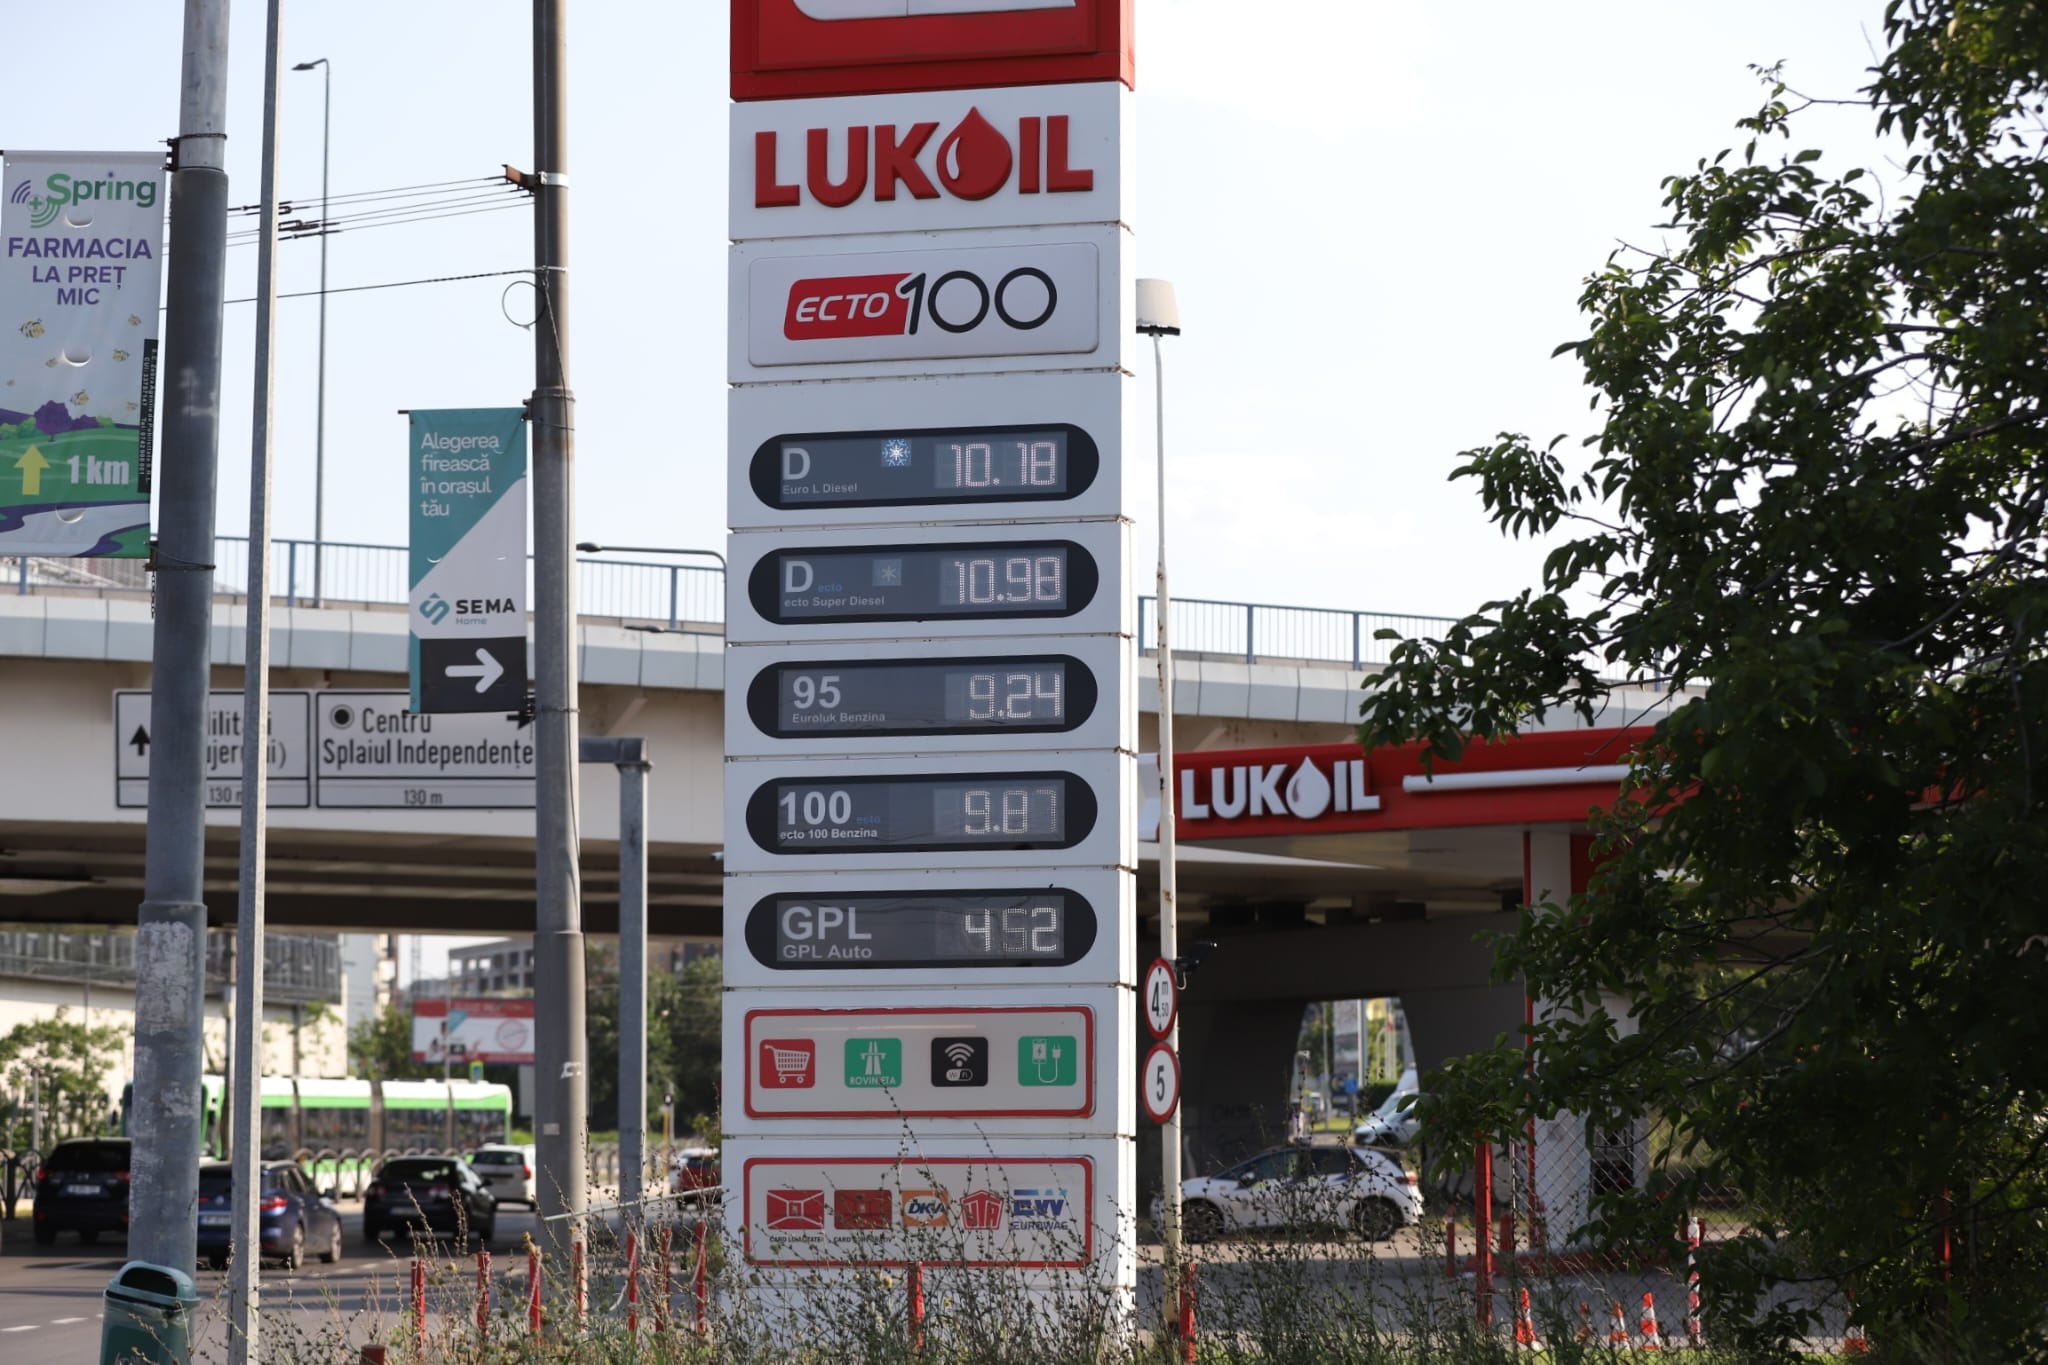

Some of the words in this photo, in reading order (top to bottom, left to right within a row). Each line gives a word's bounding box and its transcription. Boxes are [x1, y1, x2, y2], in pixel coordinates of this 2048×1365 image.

[755, 106, 1093, 208] LUKOIL
[47, 172, 157, 208] Spring
[8, 237, 153, 260] FARMACIA
[32, 265, 61, 284] LA
[68, 266, 127, 290] PREȚ
[57, 288, 100, 306] MIC
[796, 293, 890, 322] ECTO
[900, 266, 1058, 335] 100
[421, 432, 500, 453] Alegerea
[67, 455, 80, 484] 1
[87, 455, 129, 485] km
[422, 454, 490, 472] firească
[783, 448, 811, 480] D
[420, 476, 436, 494] în
[438, 476, 492, 498] orașul
[783, 484, 809, 495] Euro
[812, 483, 820, 494] L
[823, 483, 858, 493] Diesel
[420, 500, 450, 516] tău
[785, 561, 814, 593] D
[817, 582, 842, 592] ecto
[954, 556, 1061, 605] 10.98
[455, 598, 516, 614] SEMA
[784, 598, 809, 608] ecto
[812, 597, 846, 609] Super
[850, 596, 885, 606] Diesel
[793, 676, 841, 709] 95
[969, 673, 1061, 719] 9.24
[363, 708, 432, 733] Centru
[792, 712, 837, 723] Euroluk
[840, 712, 885, 723] Benzina
[324, 739, 391, 771] Splaiul
[397, 739, 533, 770] Independențe
[209, 787, 232, 802] 130
[404, 790, 427, 804] 130
[430, 795, 443, 804] m
[1181, 756, 1380, 819] LUKOIL
[780, 791, 851, 825] 100
[780, 830, 805, 839] ecto
[808, 829, 828, 839] 100
[831, 828, 878, 839] Benzina
[782, 906, 872, 941] GPL
[783, 945, 822, 959] GPL
[828, 945, 872, 959] Auto
[1156, 1065, 1165, 1102] 5
